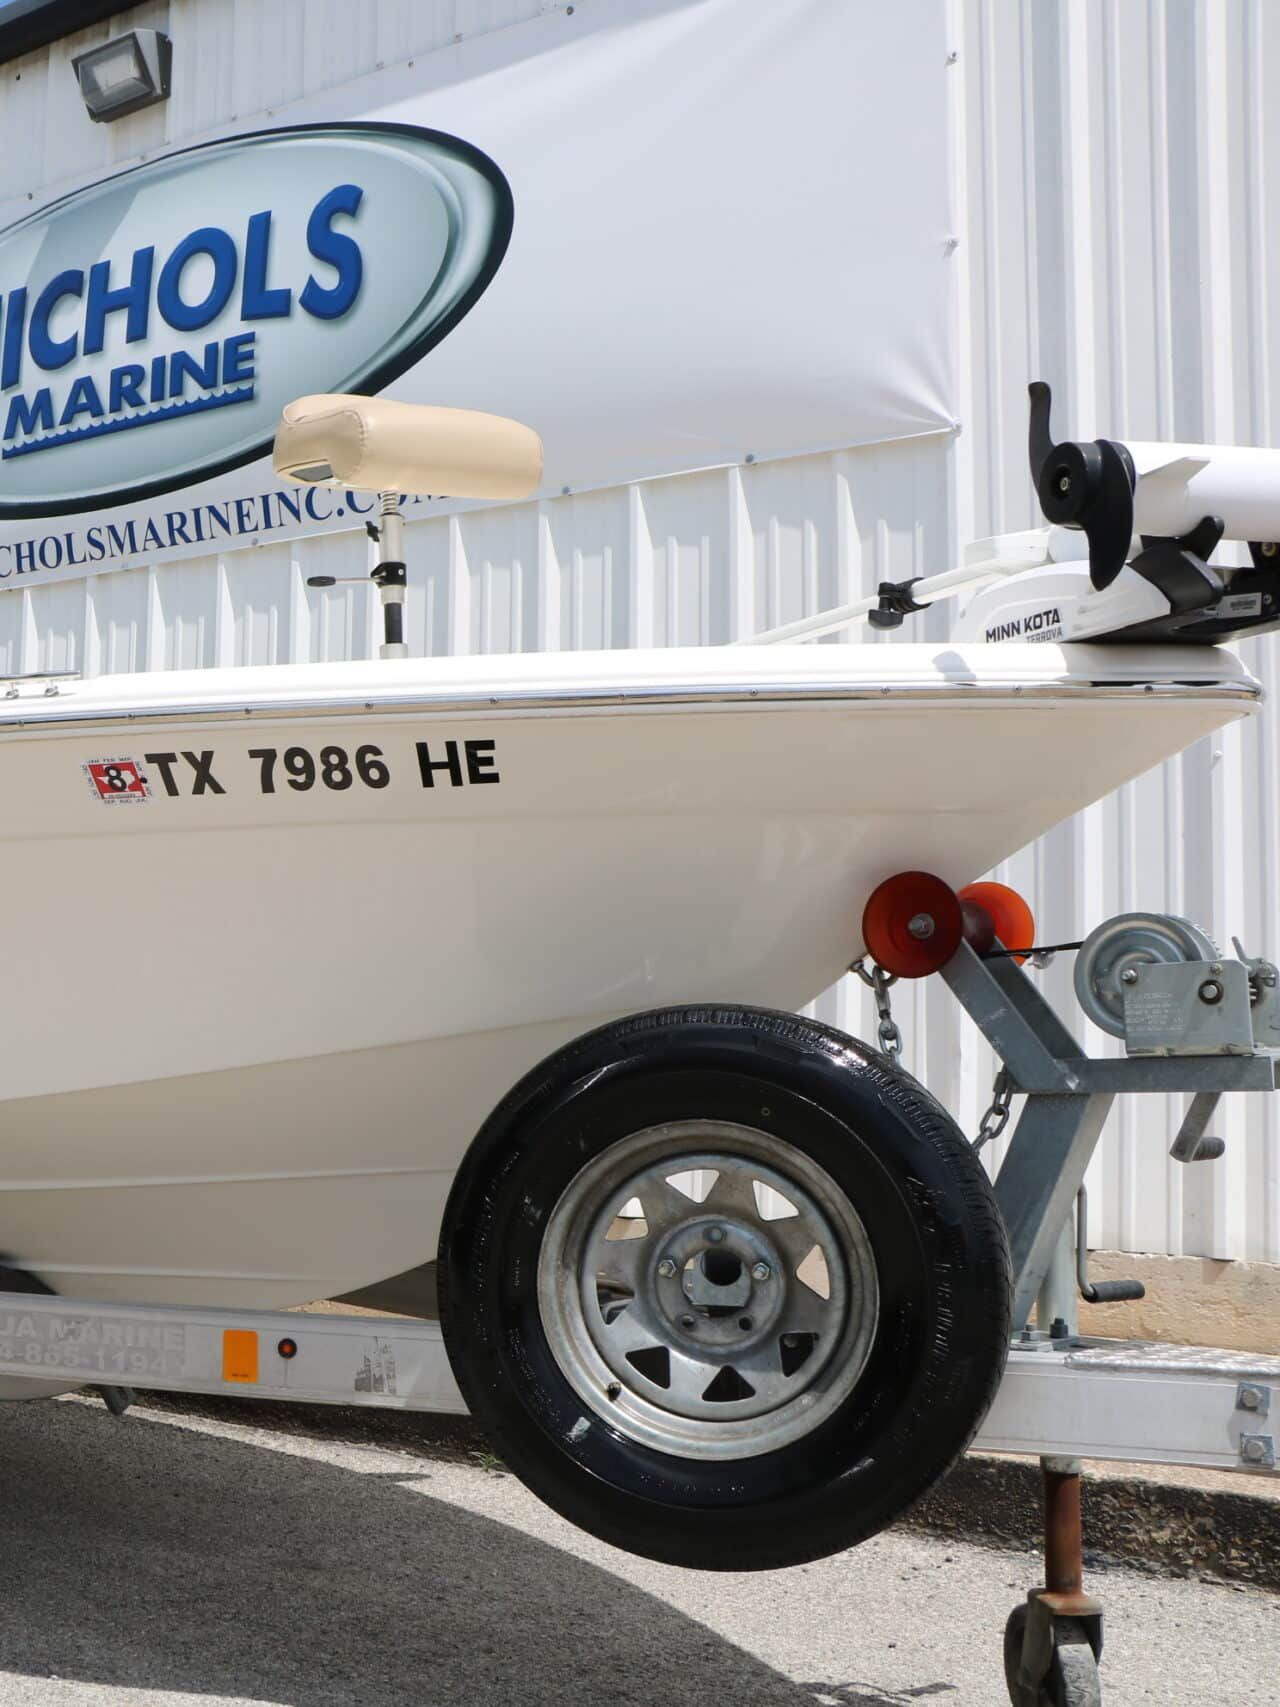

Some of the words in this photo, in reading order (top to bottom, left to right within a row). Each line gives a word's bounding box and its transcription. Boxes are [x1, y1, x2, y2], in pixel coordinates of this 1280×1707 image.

[2, 331, 257, 440] MARINE
[986, 620, 1021, 643] MINN
[1024, 608, 1062, 633] KOTA
[105, 766, 127, 792] 8
[144, 750, 226, 797] TX
[248, 744, 391, 794] 7986
[415, 739, 500, 788] HE
